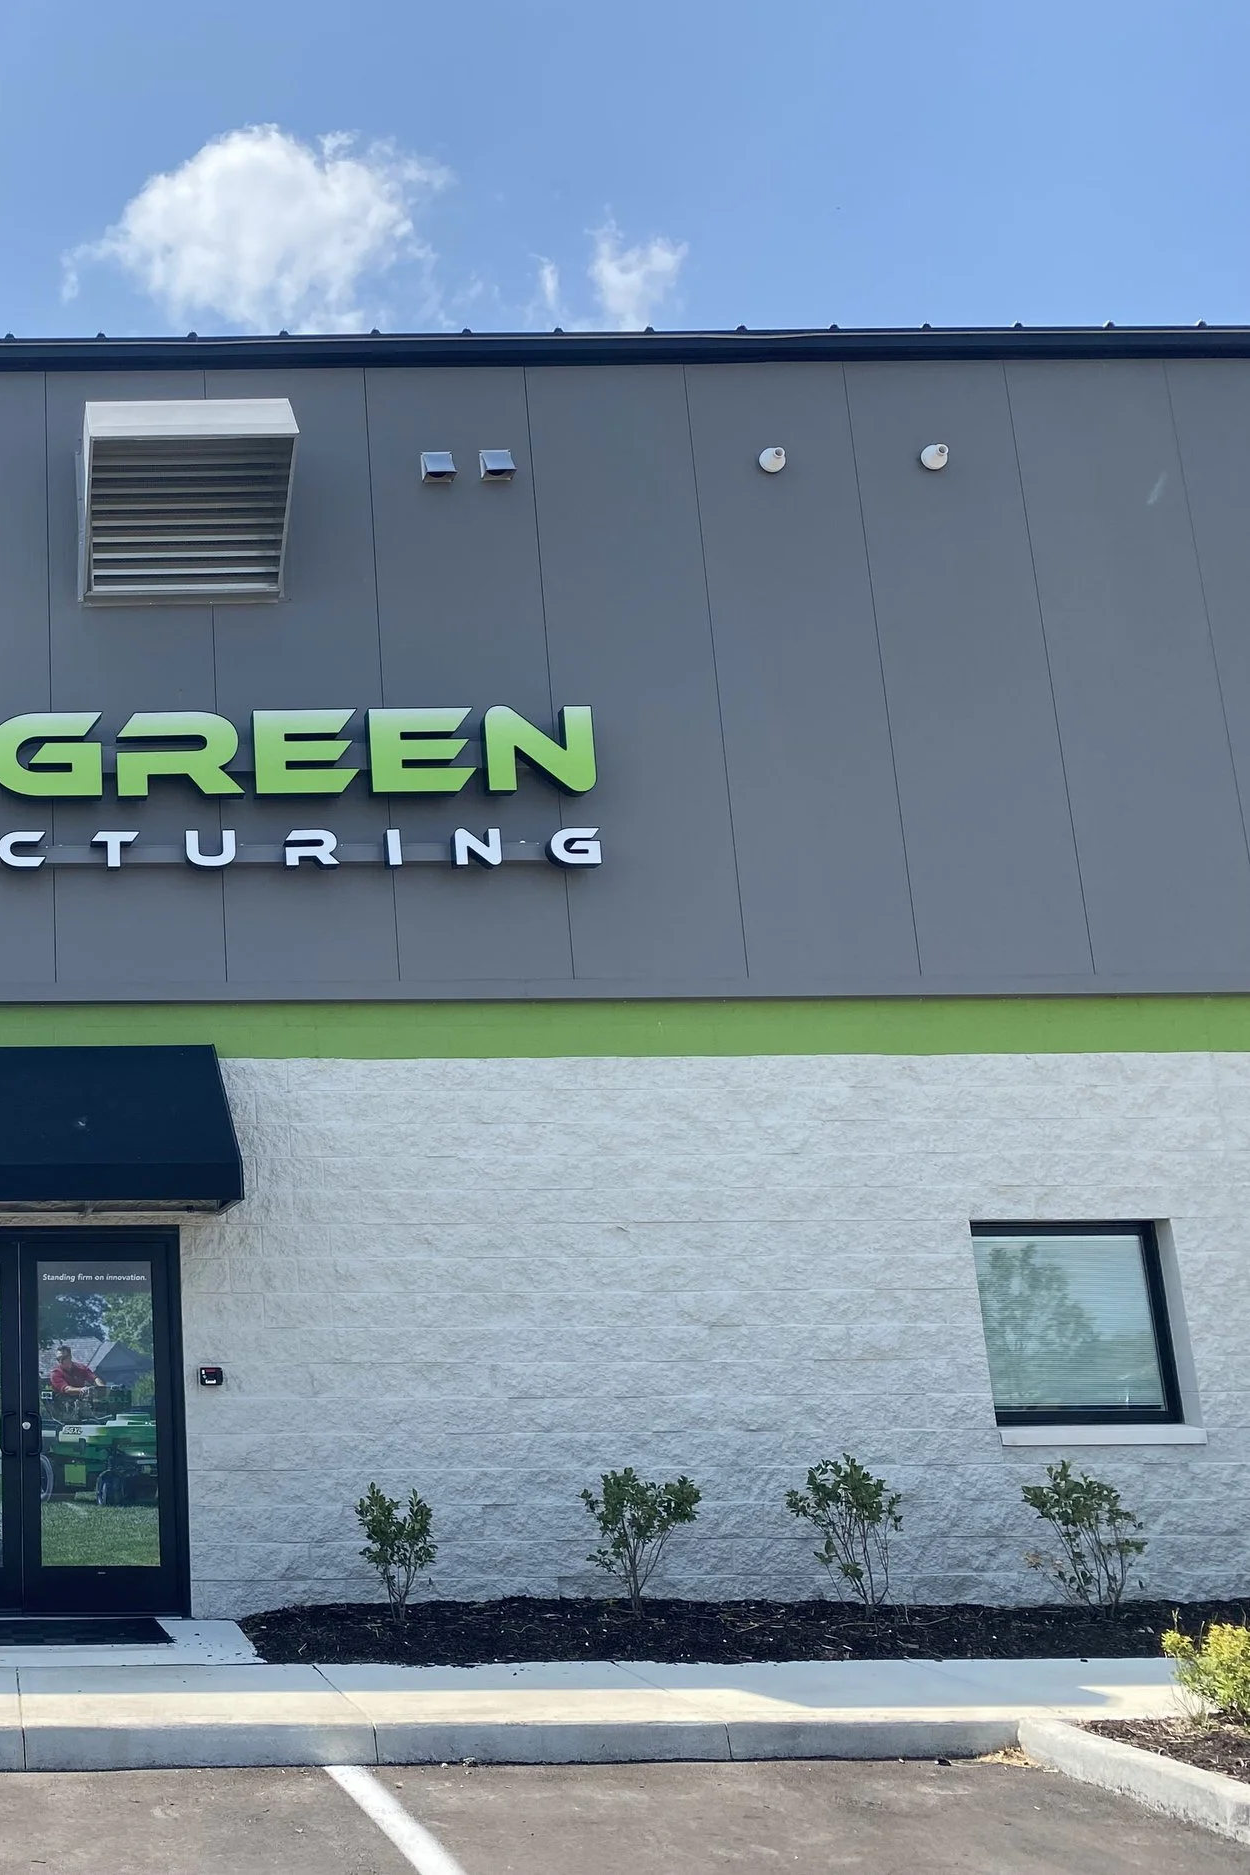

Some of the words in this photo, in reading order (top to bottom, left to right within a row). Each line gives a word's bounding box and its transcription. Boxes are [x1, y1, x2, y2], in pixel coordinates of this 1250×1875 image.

[42, 1273, 76, 1283] Standing
[77, 1273, 93, 1281] firm
[106, 1273, 147, 1281] innovation.
